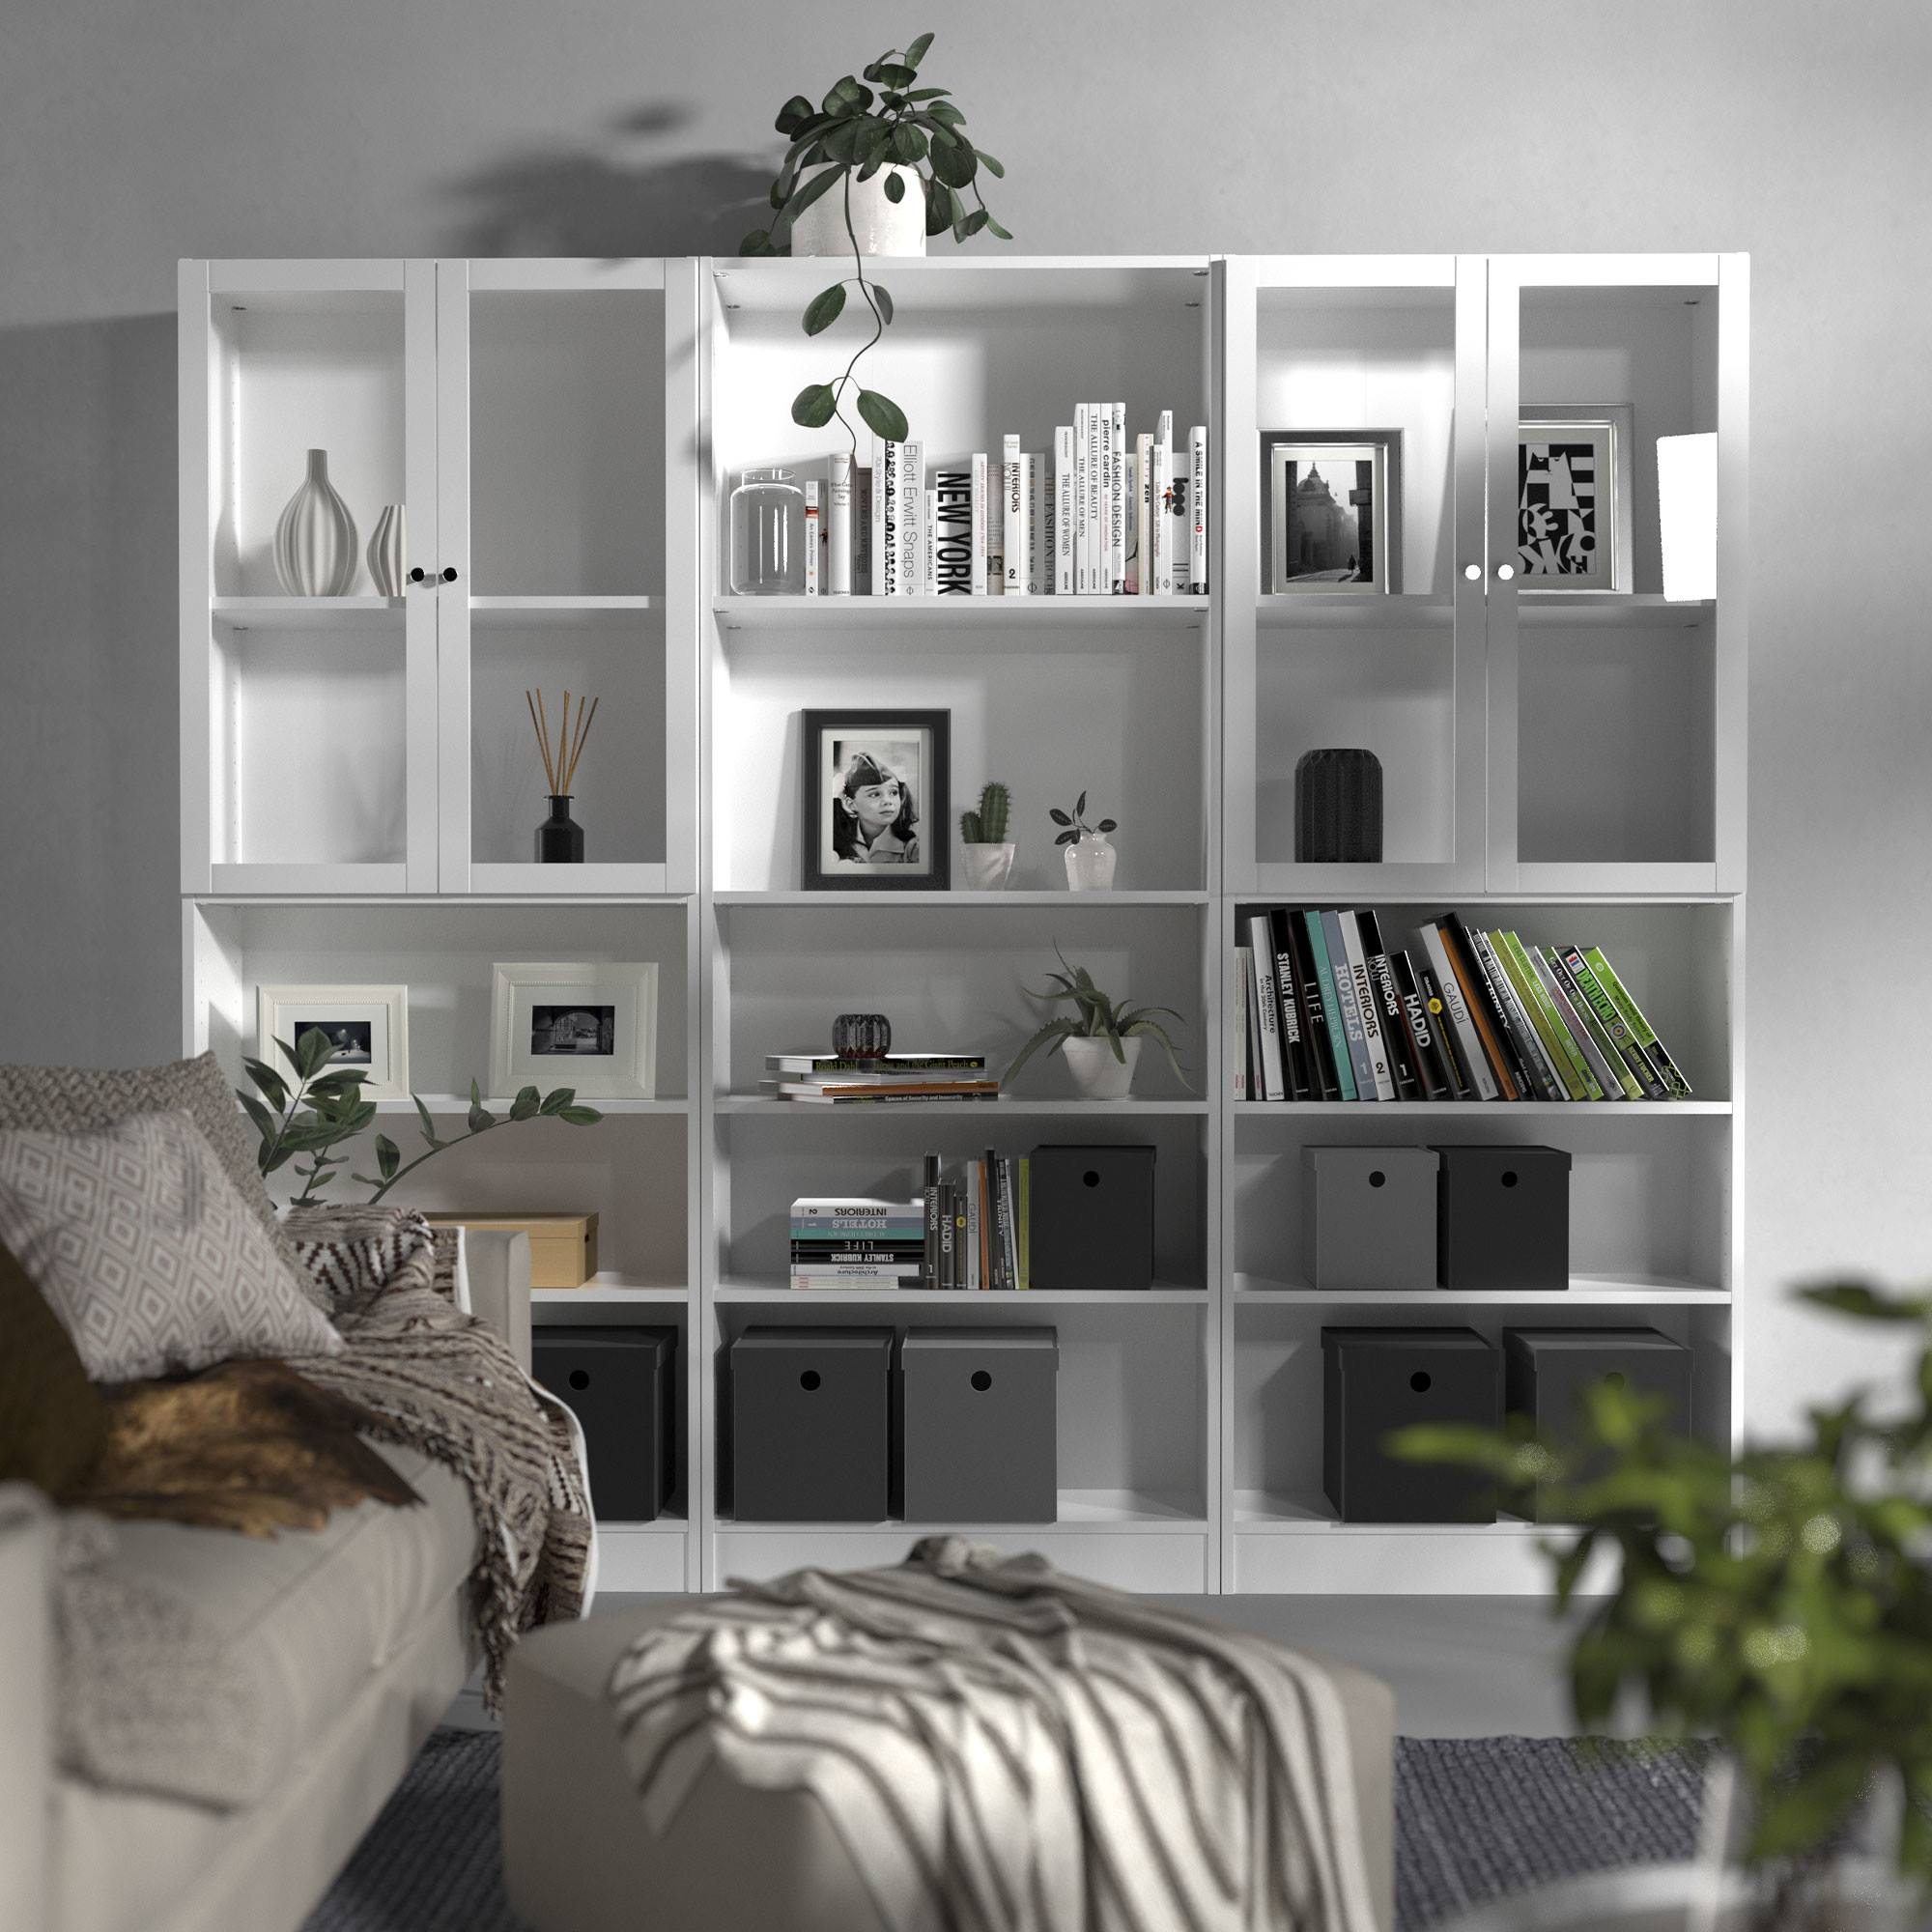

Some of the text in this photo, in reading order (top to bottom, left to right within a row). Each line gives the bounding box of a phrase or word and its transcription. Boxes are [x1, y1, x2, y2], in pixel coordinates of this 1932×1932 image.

[1102, 419, 1111, 451] pierre
[873, 469, 882, 487] Style
[1011, 462, 1020, 513] INTERIORS
[1091, 470, 1098, 483] OF
[1112, 451, 1122, 501] FASHION
[873, 496, 883, 523] Design
[900, 444, 918, 579] Elliott Erwitt Snaps
[1044, 503, 1055, 557] FASHION
[1062, 473, 1070, 556] THE ALLURE OF WOMEN
[1078, 507, 1085, 517] OF
[1112, 505, 1122, 548] DESIGN
[937, 472, 972, 595] NEW YORK
[1009, 569, 1015, 579] 2
[1264, 975, 1275, 1034] Architecture
[1276, 952, 1300, 1044] STANLEY KUBRICK
[1304, 981, 1324, 1024] LIFE
[1334, 964, 1362, 1041] HOTELS
[1353, 964, 1378, 1038] INTERIORS
[1375, 953, 1400, 1016] INTERIORS
[1443, 982, 1469, 1024] GAUDÍ
[1485, 981, 1511, 1030] TRINITY
[1575, 968, 1617, 1022] DEATH ECHO
[1405, 993, 1431, 1047] HADID
[815, 1061, 838, 1071] Roald
[839, 1061, 858, 1070] Dahl
[896, 1061, 910, 1069] and
[1376, 1062, 1385, 1074] 2
[832, 1218, 888, 1229] HOTELS
[835, 1208, 887, 1216] INTERIORS
[929, 1186, 938, 1231] INTERIORS
[844, 1240, 873, 1250] LIFE
[942, 1214, 952, 1253] HADID
[831, 1253, 895, 1262] STANLEY KUBRICK
